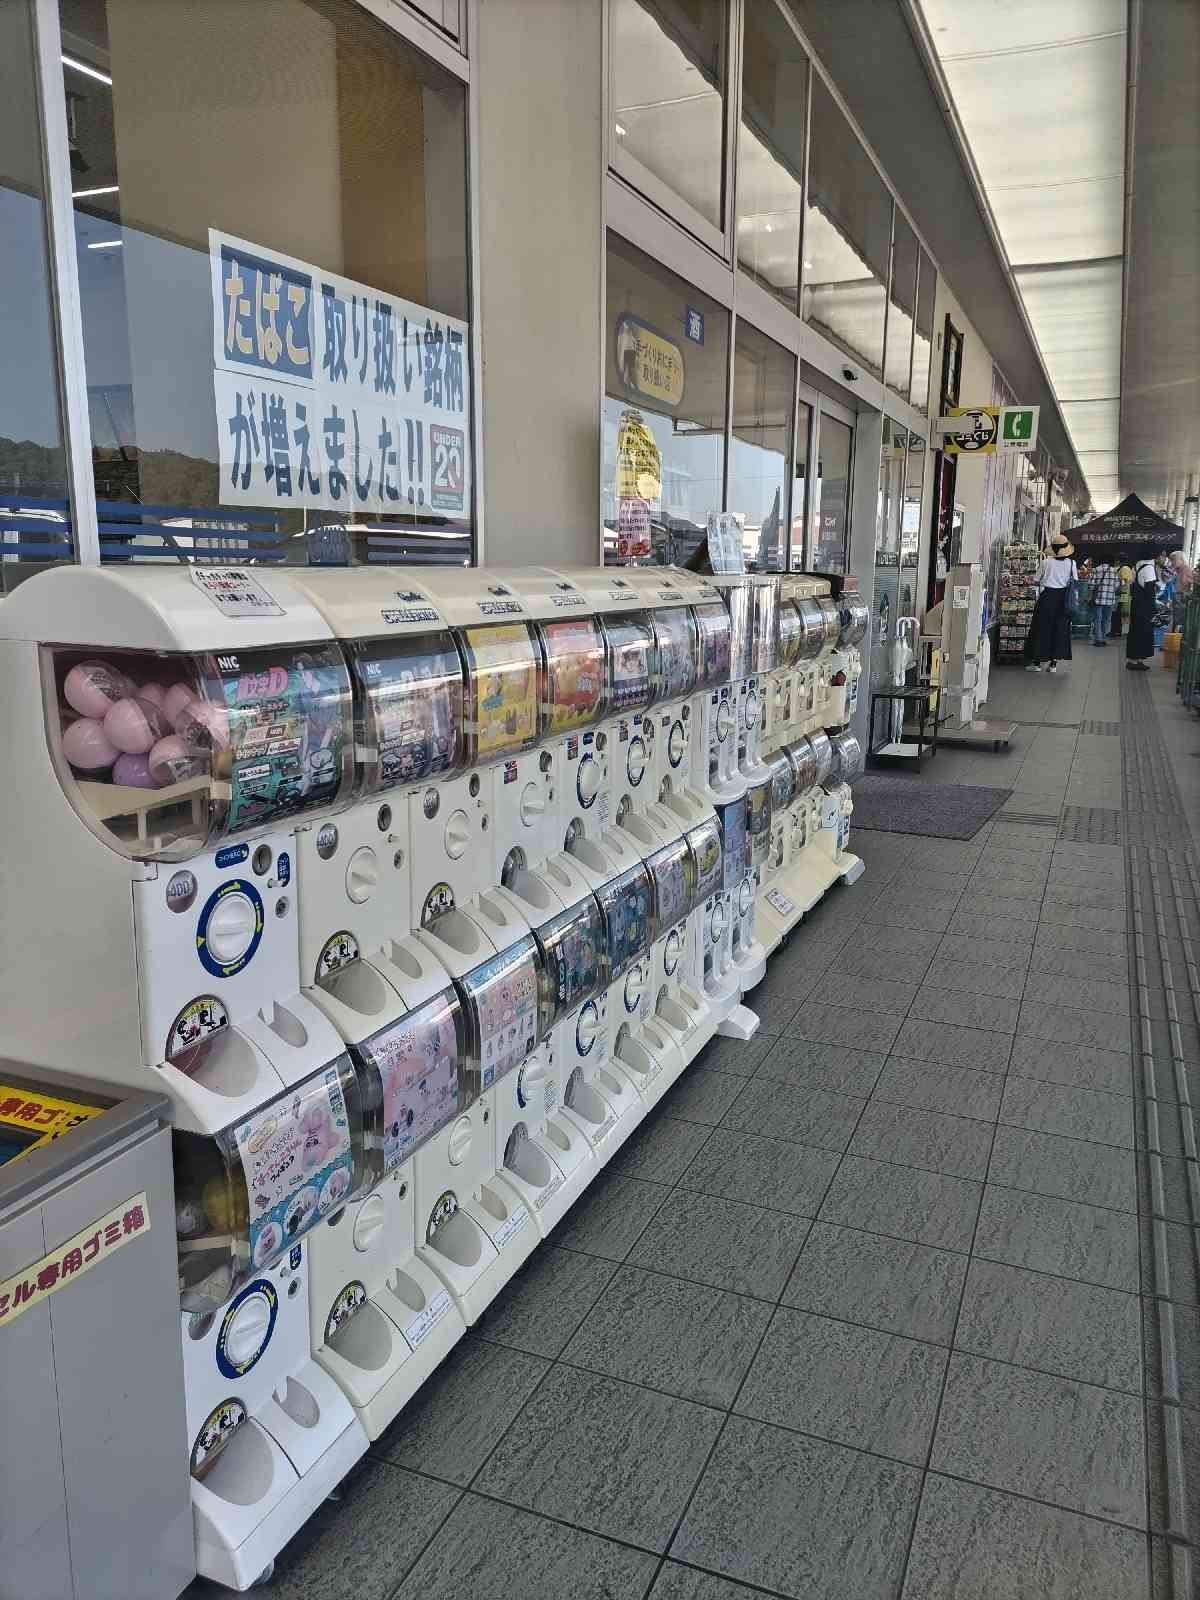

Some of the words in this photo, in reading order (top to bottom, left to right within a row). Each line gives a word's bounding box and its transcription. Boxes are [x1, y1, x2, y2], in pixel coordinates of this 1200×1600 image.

[225, 257, 311, 366] たばこ
[433, 431, 462, 446] UNDER
[217, 655, 240, 670] NIC
